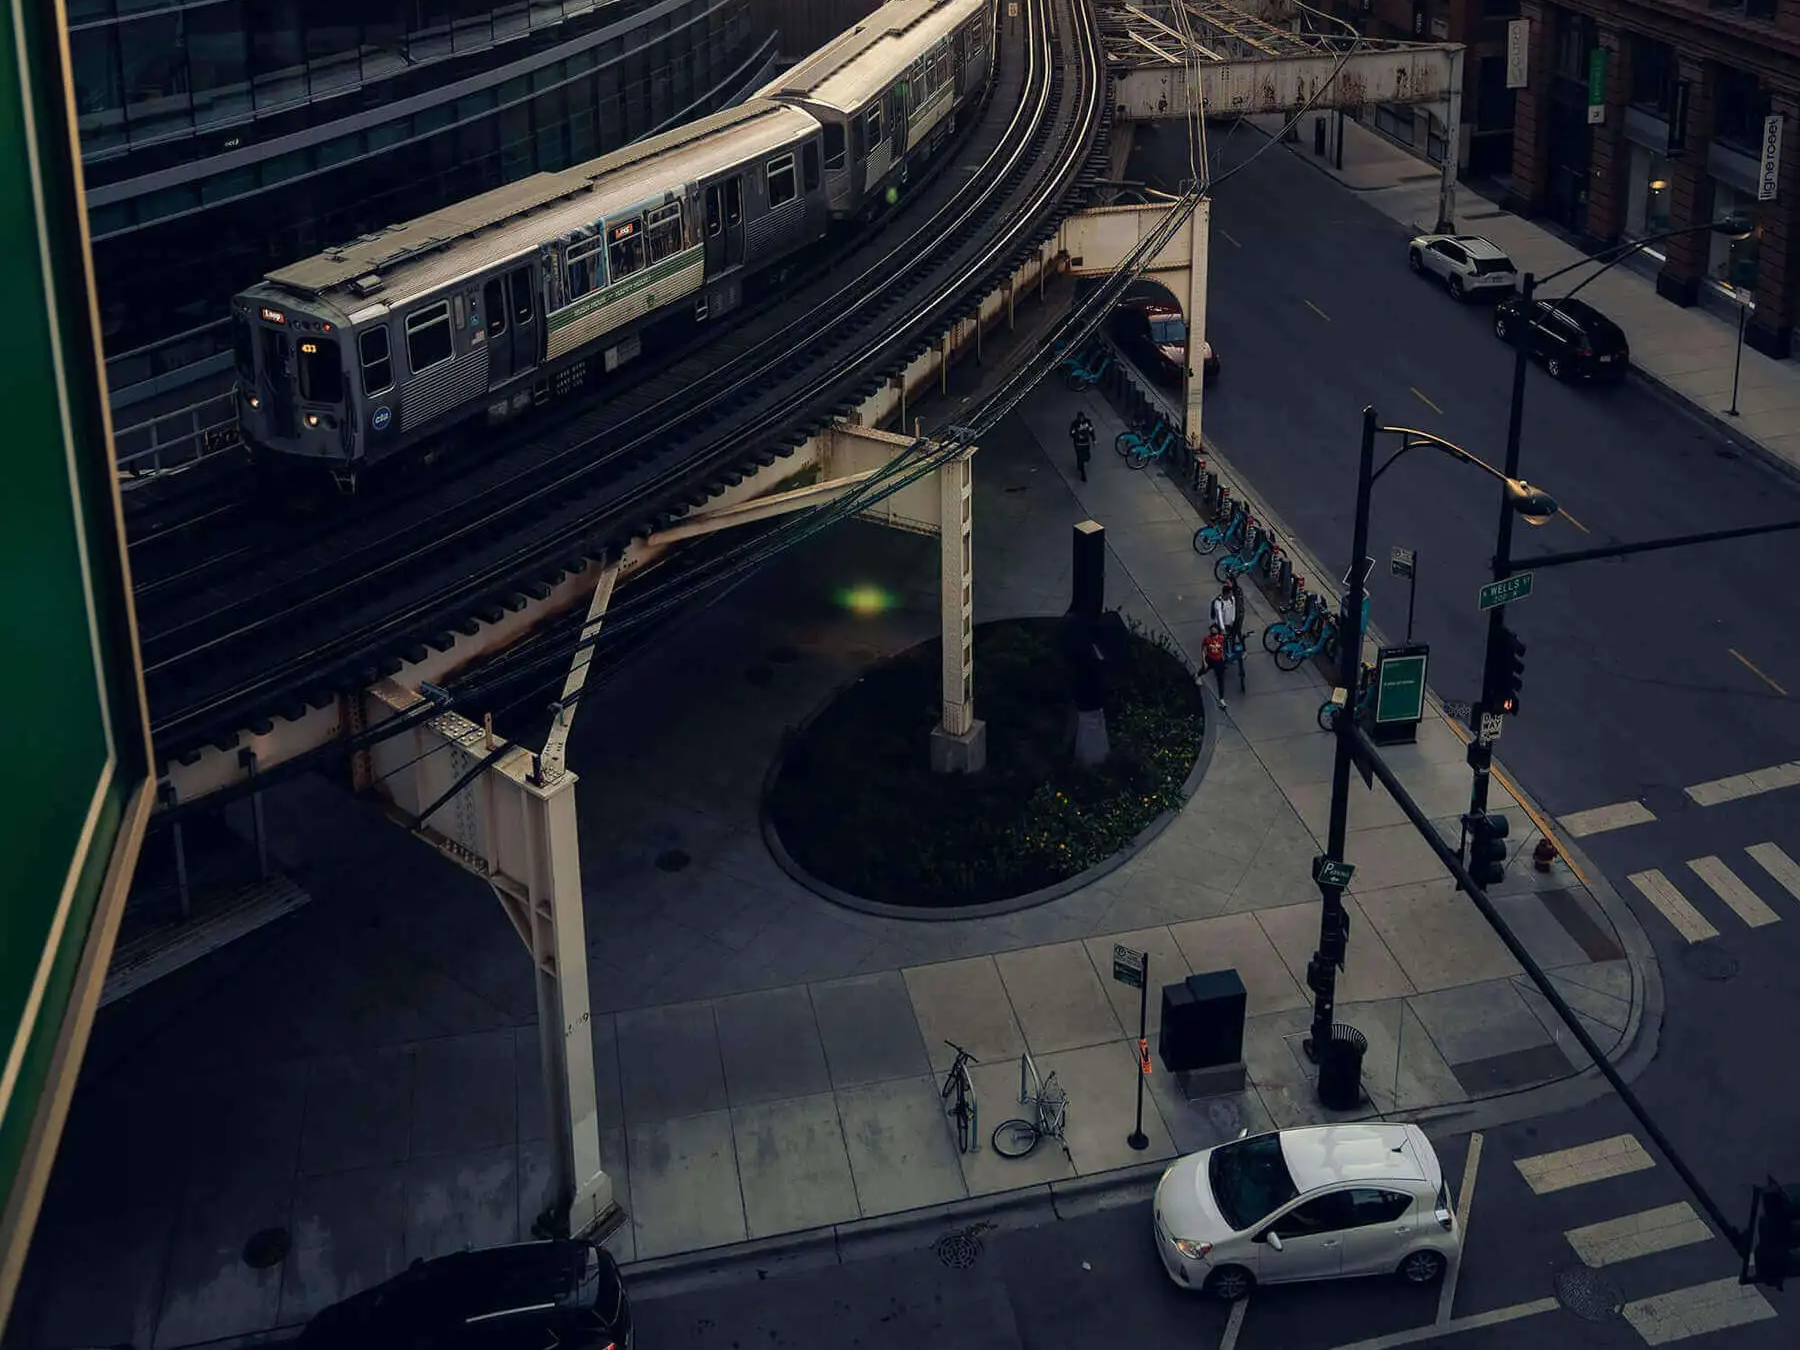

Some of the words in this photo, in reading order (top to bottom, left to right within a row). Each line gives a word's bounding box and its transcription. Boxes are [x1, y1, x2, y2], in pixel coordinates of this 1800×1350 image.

[1765, 118, 1779, 159] roset
[1759, 161, 1776, 199] ligne
[1490, 579, 1519, 595] WELLS
[1483, 720, 1501, 729] WAY
